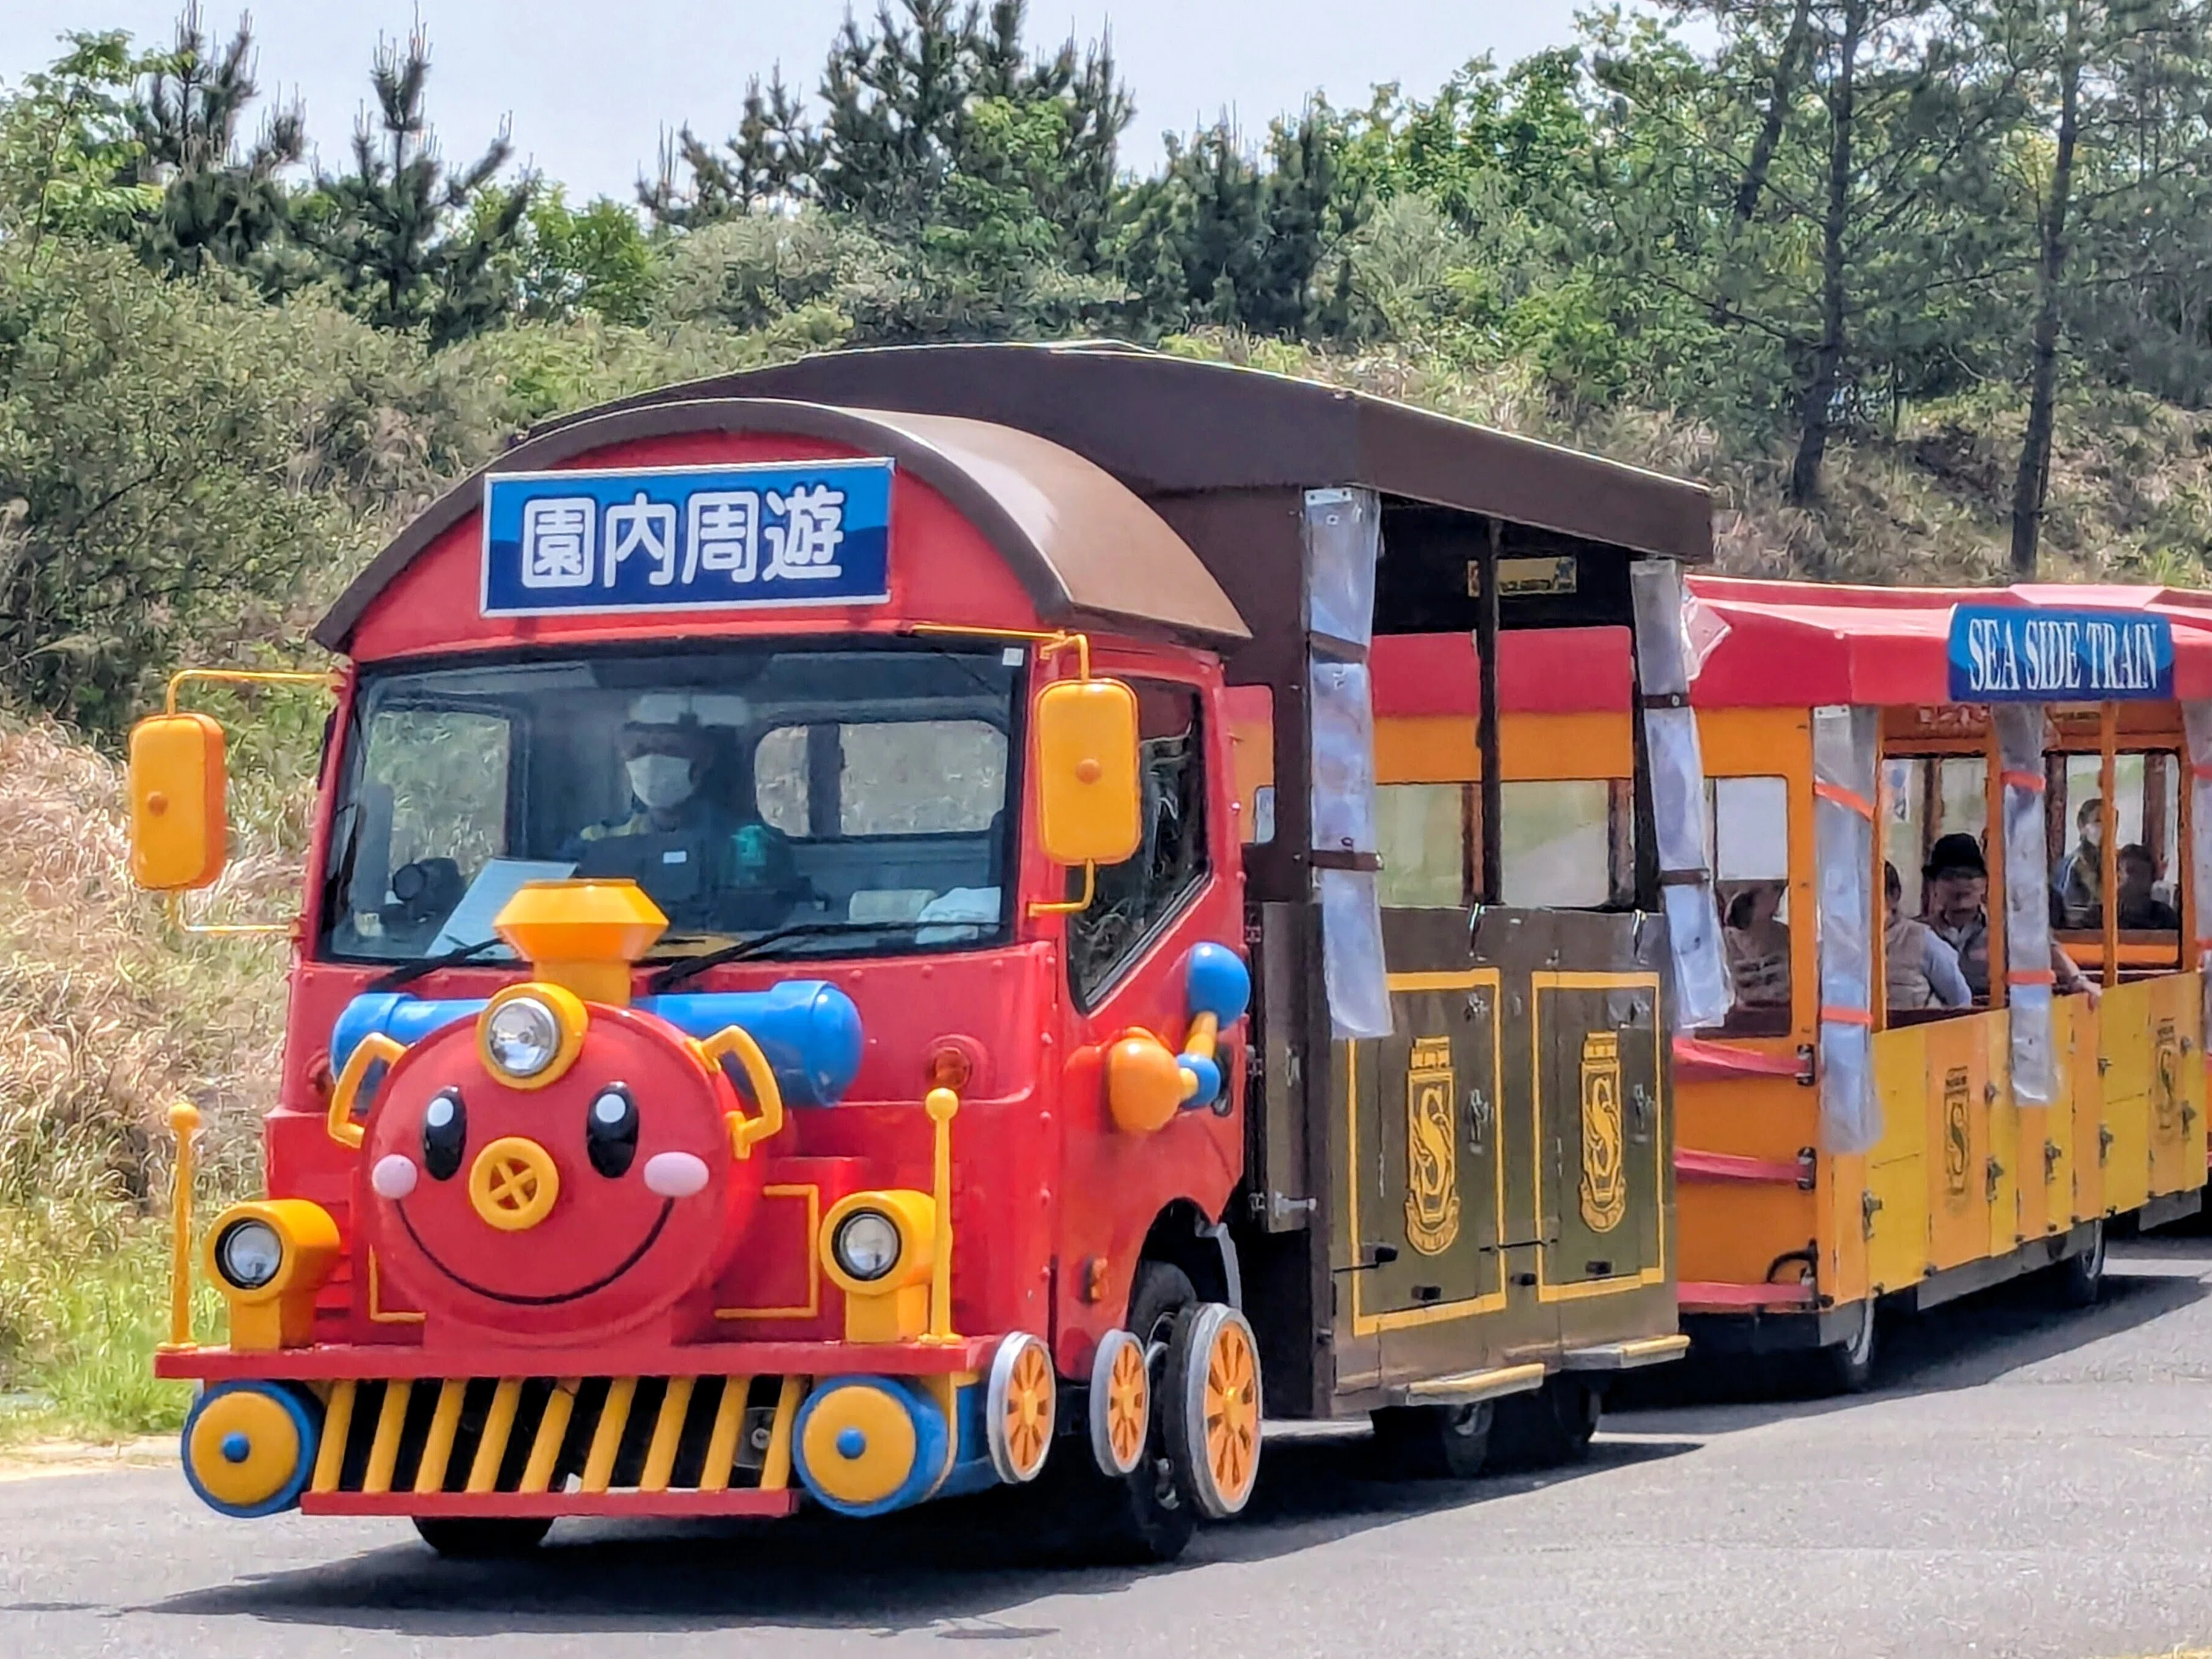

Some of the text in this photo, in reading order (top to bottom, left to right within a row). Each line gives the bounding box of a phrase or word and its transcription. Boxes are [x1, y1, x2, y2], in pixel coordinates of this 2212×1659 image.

[522, 484, 845, 588] 園内周遊
[1969, 618, 2157, 691] SEA SIDE TRAIN
